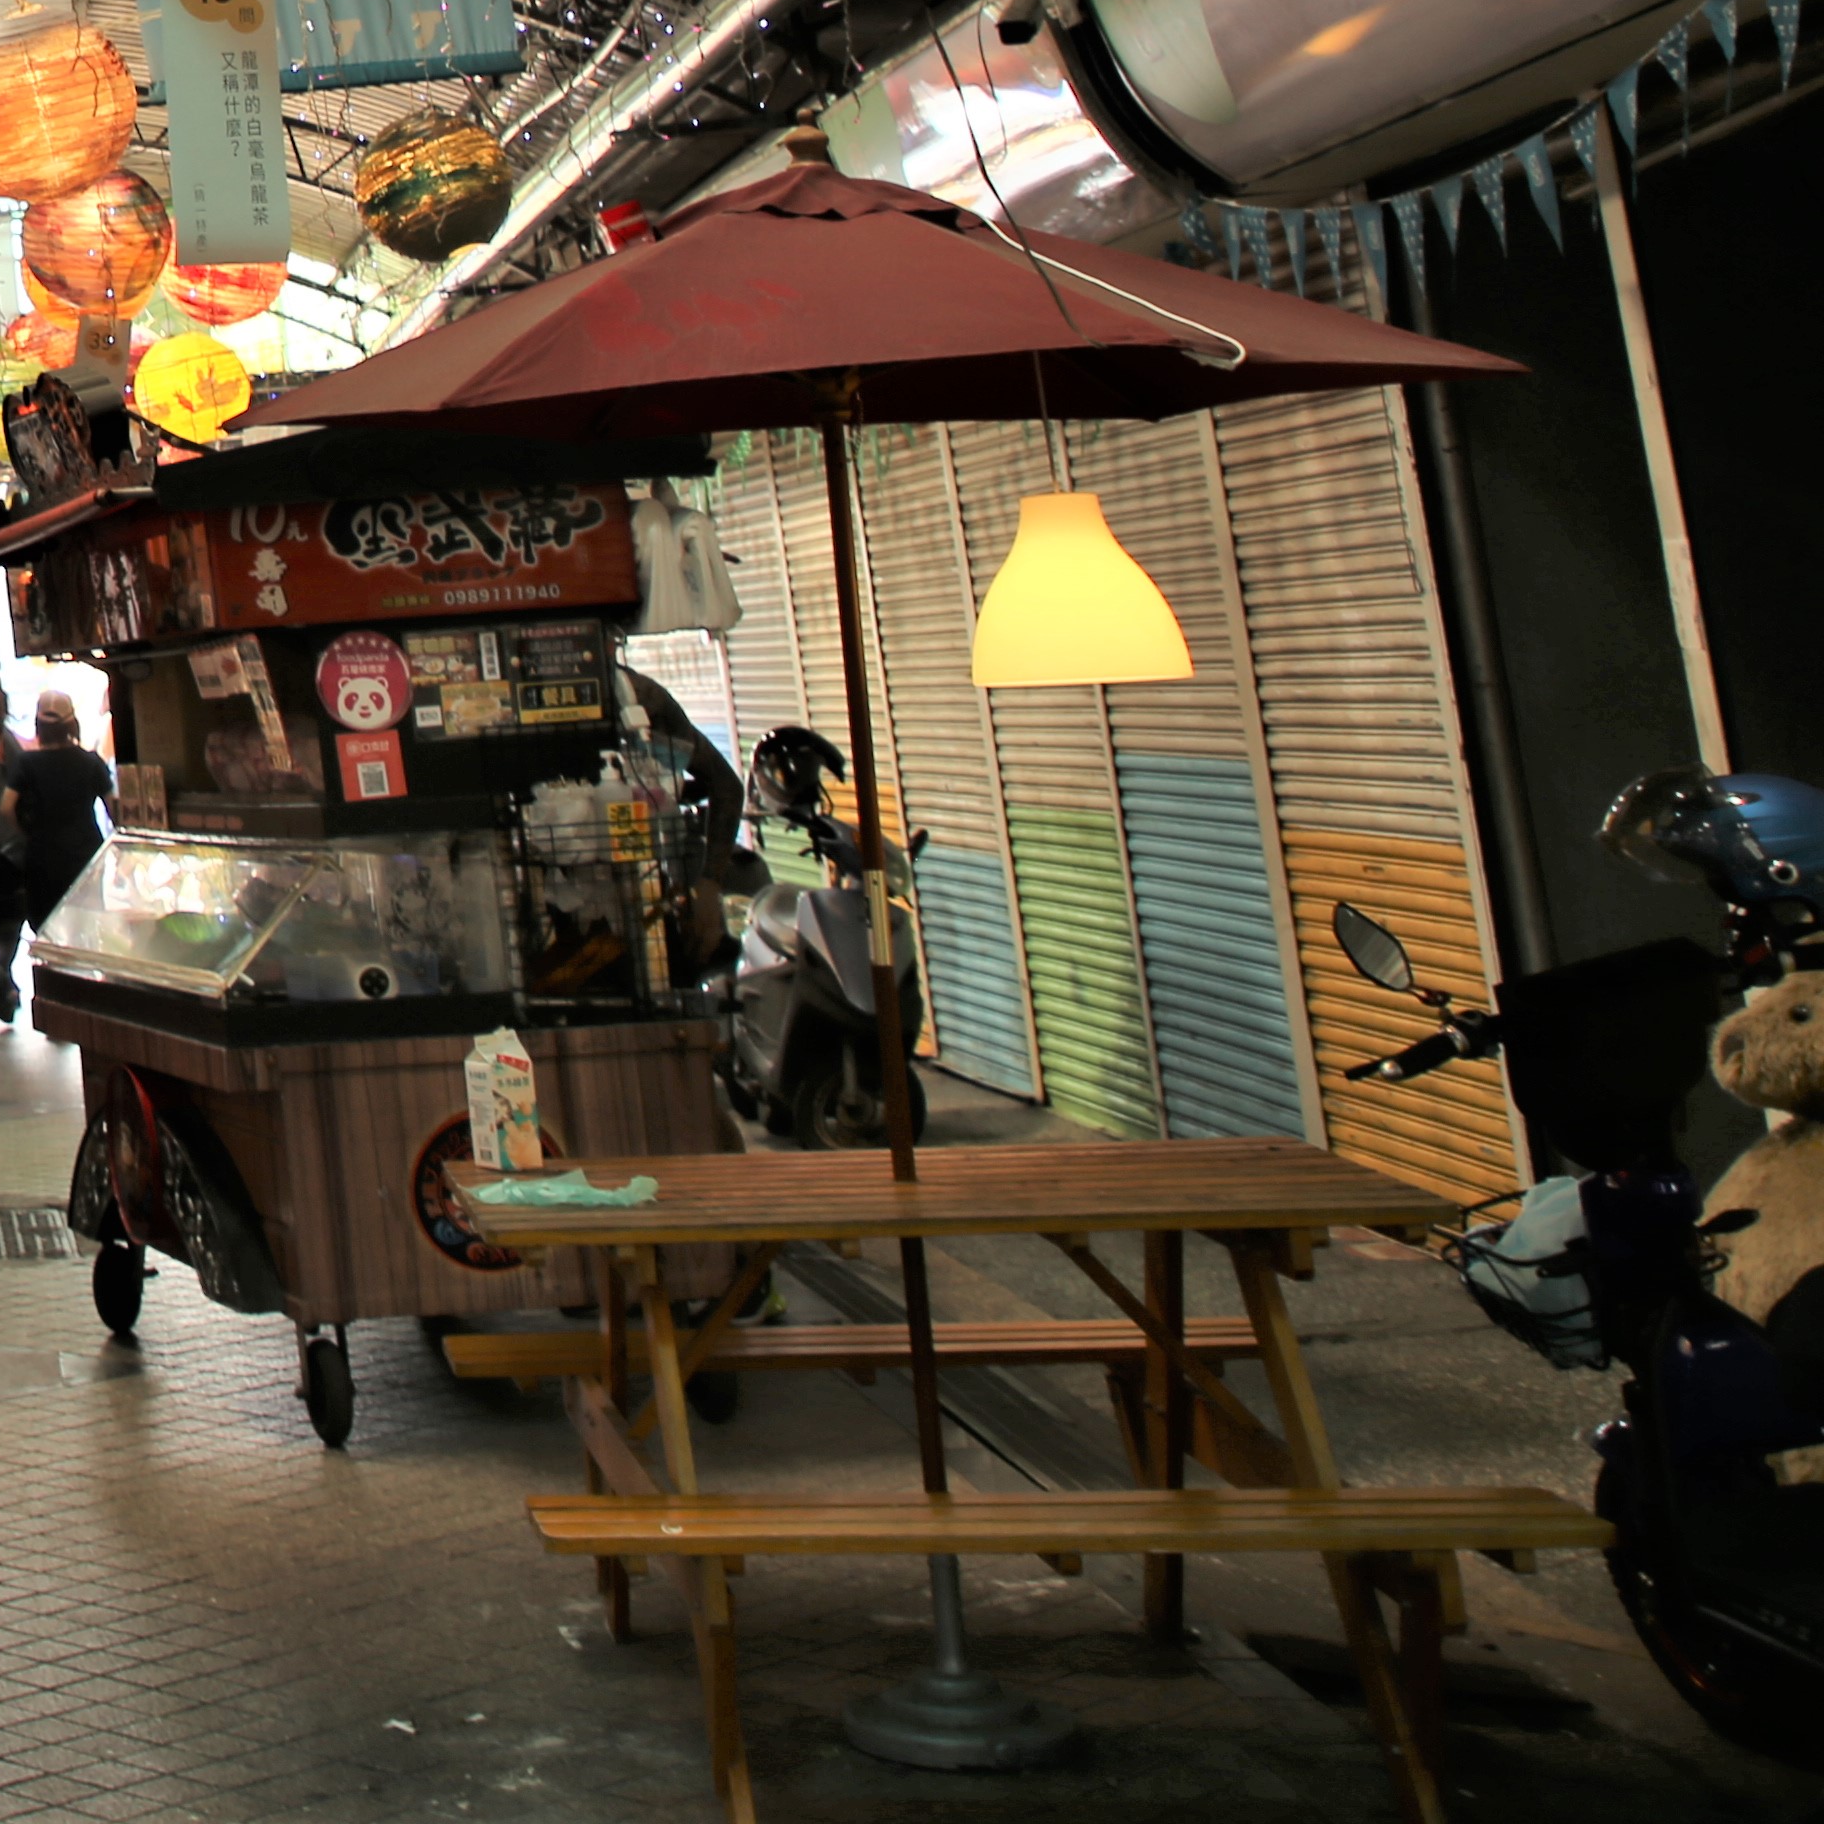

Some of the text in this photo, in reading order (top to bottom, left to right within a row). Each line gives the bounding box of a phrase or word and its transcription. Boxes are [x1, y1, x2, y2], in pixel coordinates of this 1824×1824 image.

[241, 49, 270, 227] 龍潭的白毫烏龍茶
[443, 583, 562, 607] 0989111940
